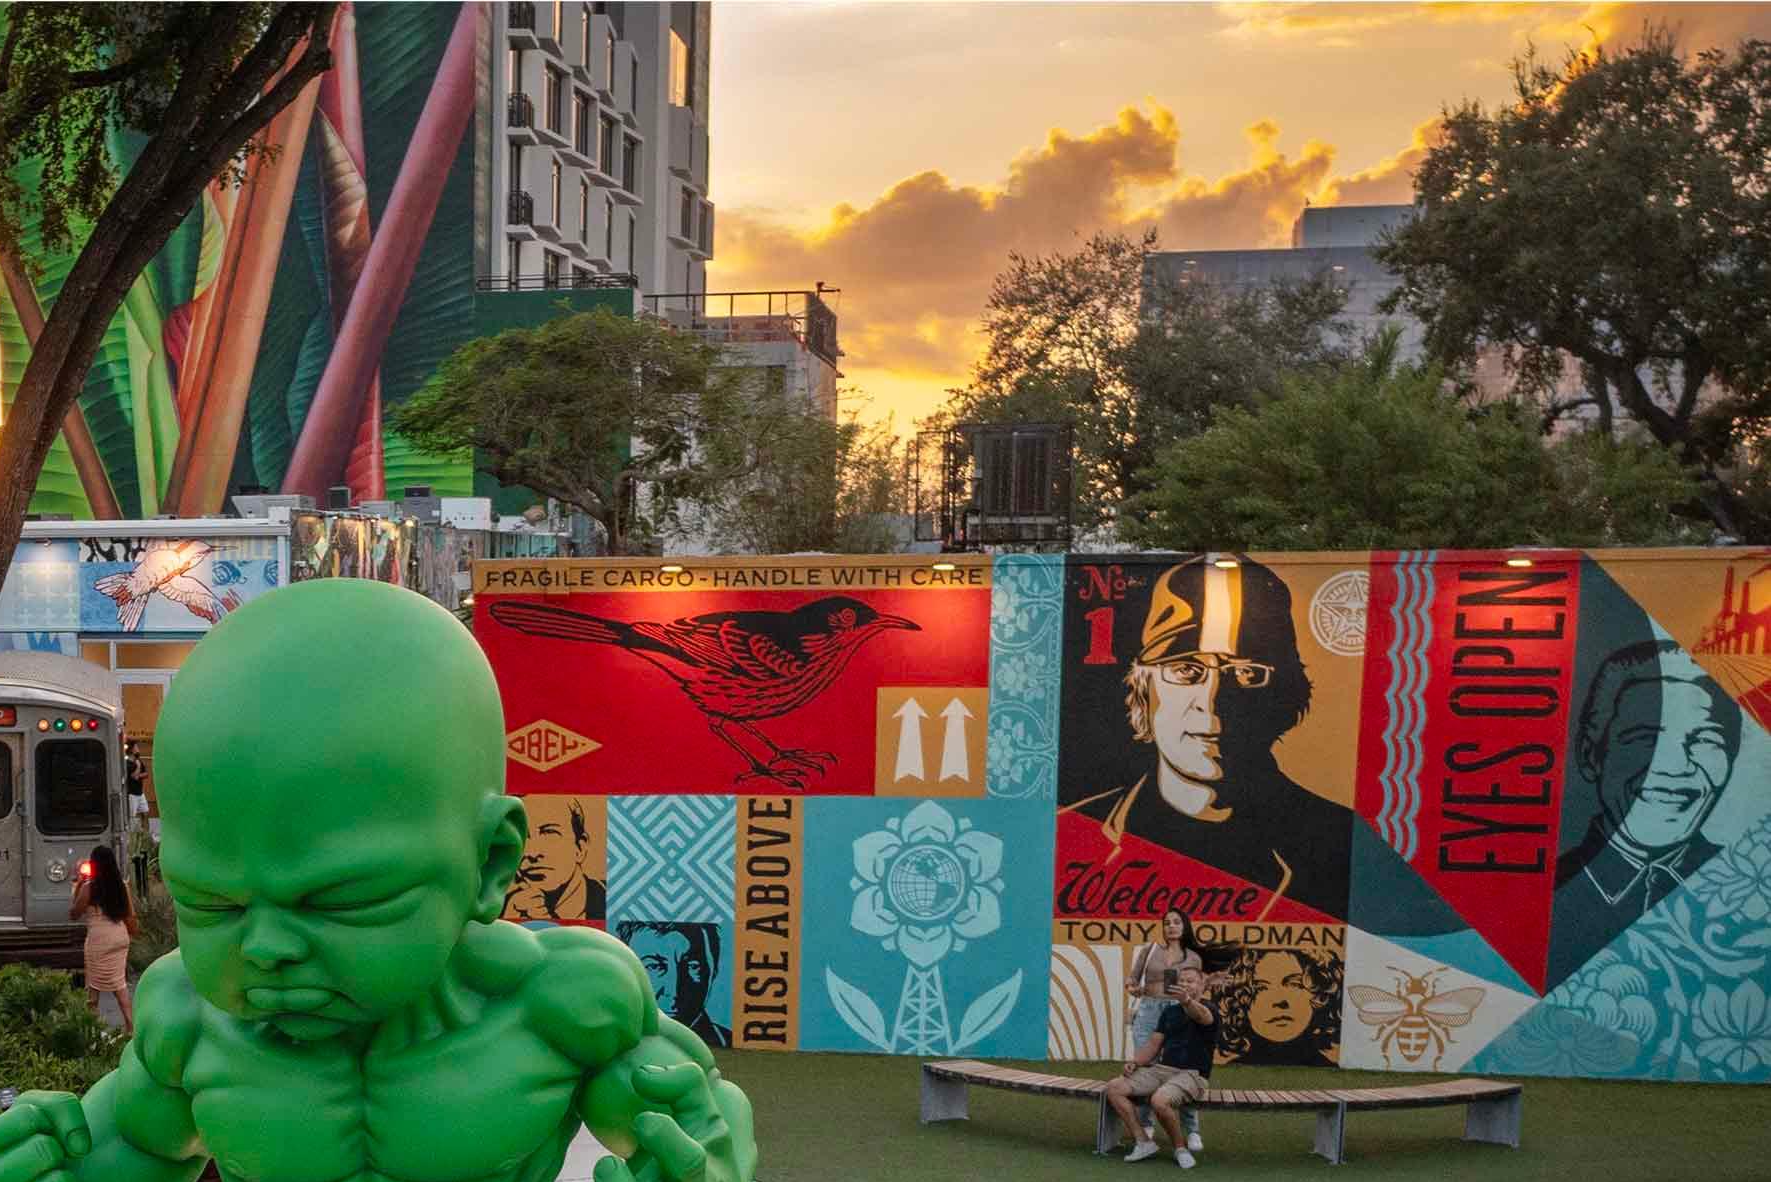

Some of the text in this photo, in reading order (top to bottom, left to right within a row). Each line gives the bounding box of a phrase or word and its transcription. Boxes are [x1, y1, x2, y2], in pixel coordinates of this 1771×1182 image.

[485, 569, 595, 588] FRAGILE
[603, 569, 695, 588] CARGO
[713, 569, 822, 587] HANDLE
[831, 568, 902, 586] WITH
[910, 568, 984, 585] CARE
[1083, 606, 1117, 665] 1
[1438, 571, 1569, 874] EYES OPEN
[1058, 861, 1259, 916] Welcome
[743, 798, 793, 1045] RISE ABOVE
[1060, 920, 1346, 946] TONY OLDMAN
